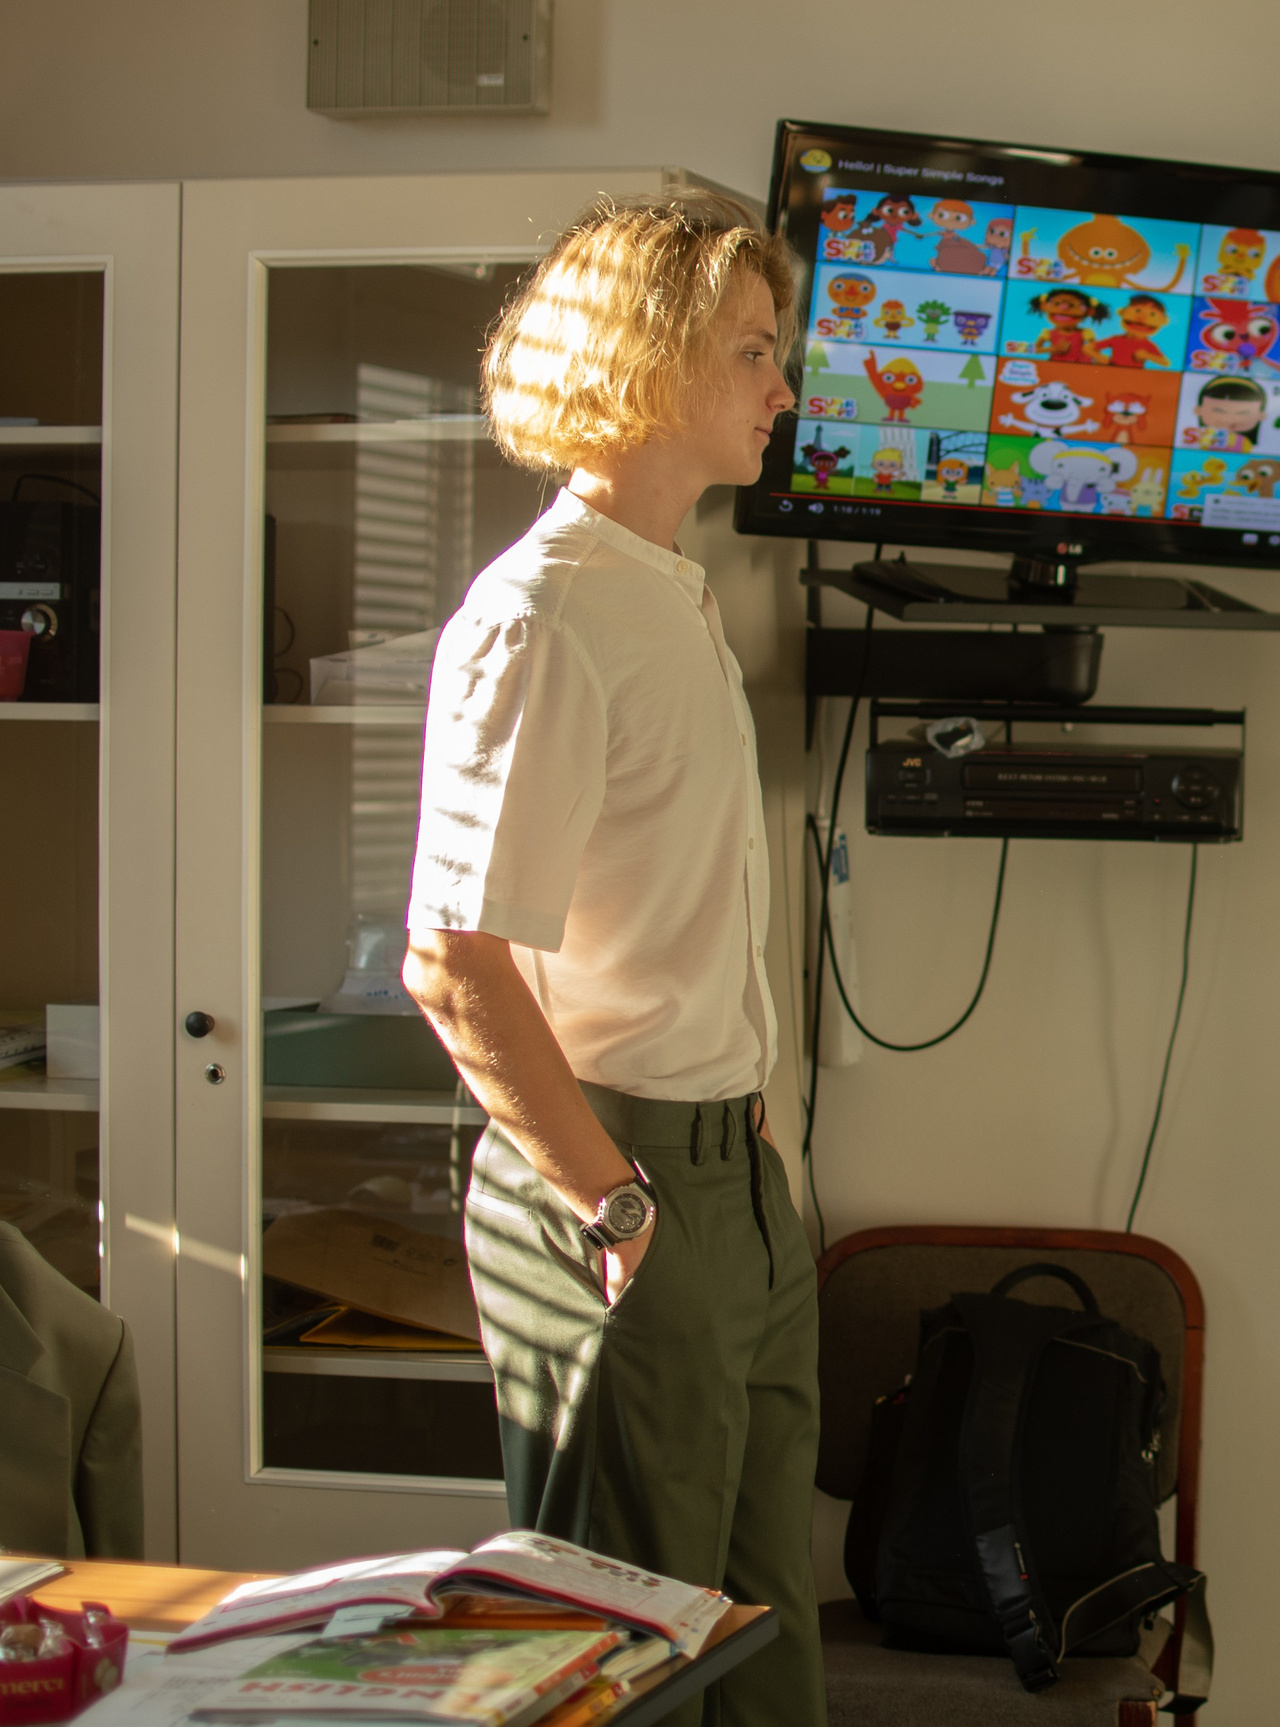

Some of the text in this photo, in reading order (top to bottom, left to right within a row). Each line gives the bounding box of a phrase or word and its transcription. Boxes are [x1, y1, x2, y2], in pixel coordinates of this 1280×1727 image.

[838, 159, 875, 172] Hello!
[883, 164, 919, 179] Super
[921, 167, 964, 182] Simple
[966, 172, 1005, 187] Songs
[902, 758, 922, 768] JVC
